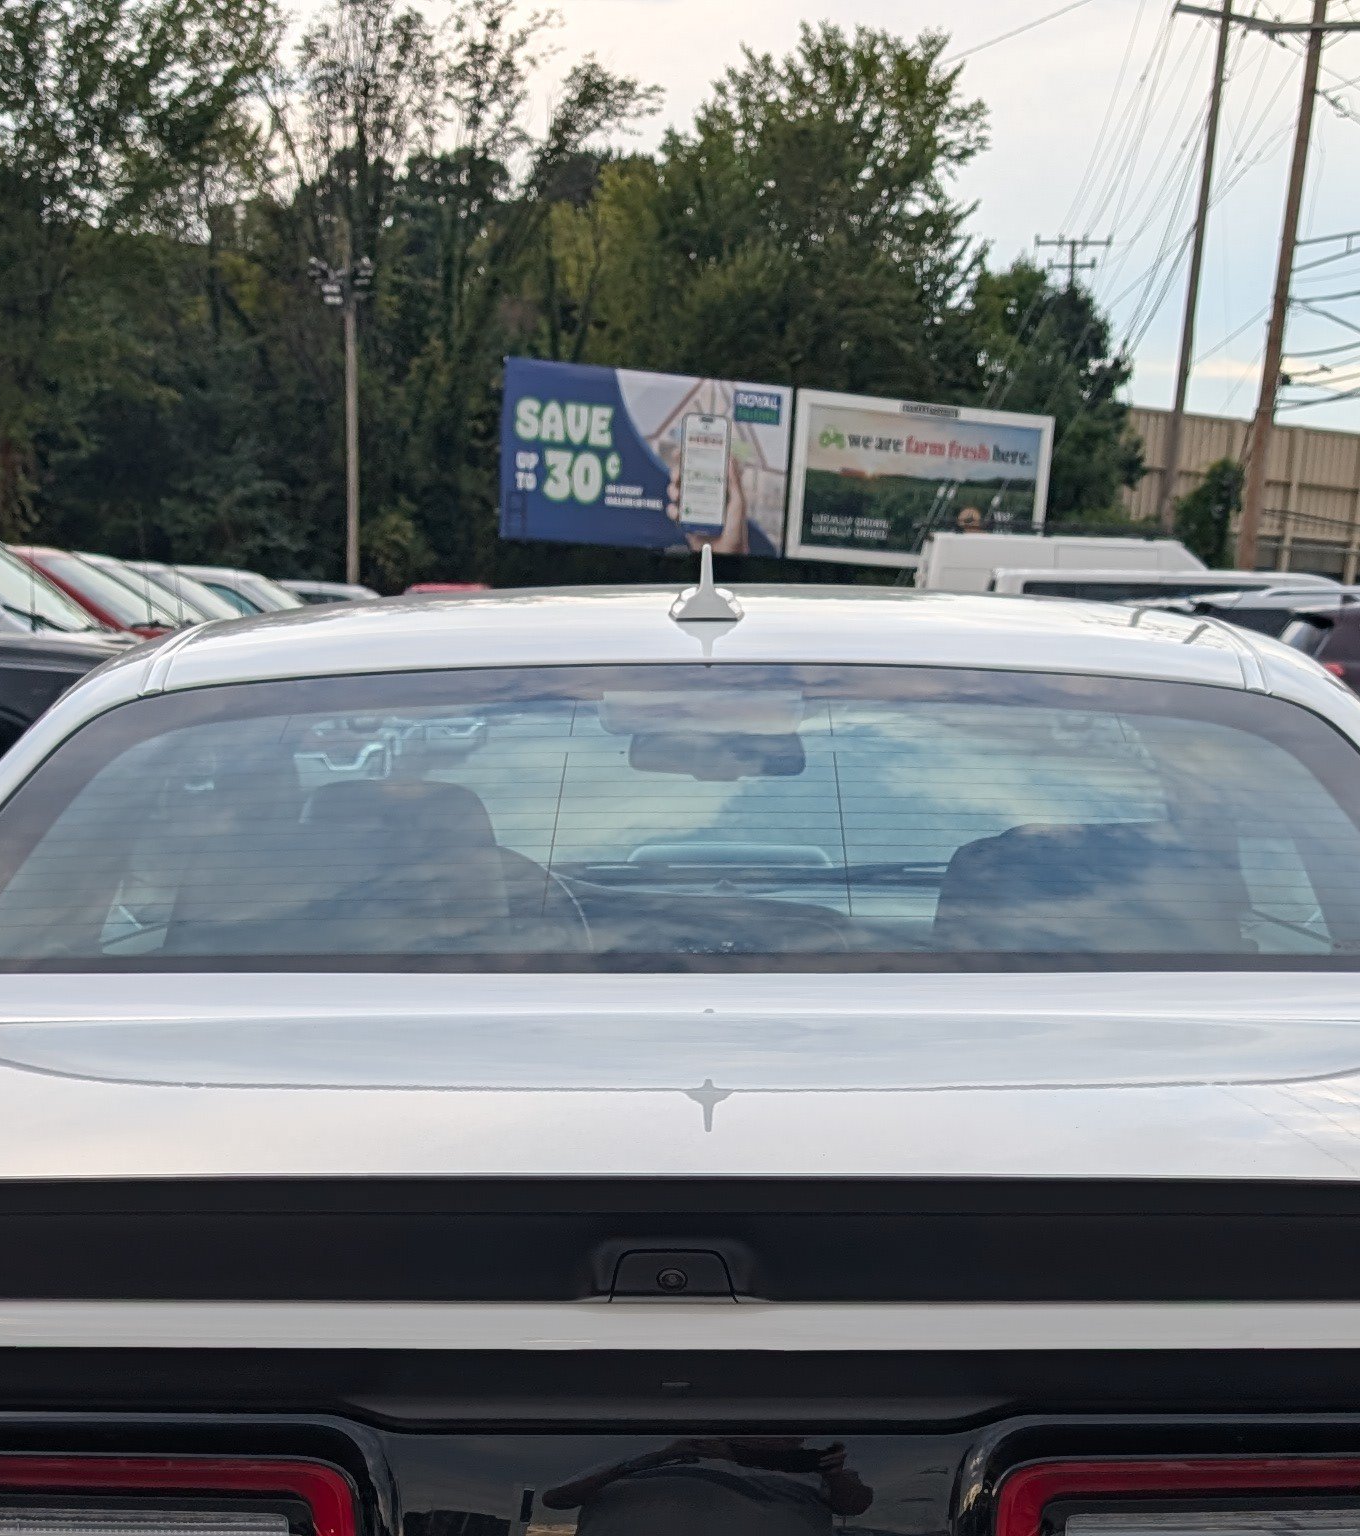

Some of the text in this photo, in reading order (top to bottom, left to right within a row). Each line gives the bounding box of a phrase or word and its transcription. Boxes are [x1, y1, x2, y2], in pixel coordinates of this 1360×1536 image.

[515, 398, 614, 447] SAVE
[847, 433, 871, 450] we
[876, 436, 904, 451] are
[906, 435, 946, 456] farm
[948, 439, 990, 463] fresh
[515, 451, 539, 471] UP
[515, 472, 538, 491] TO
